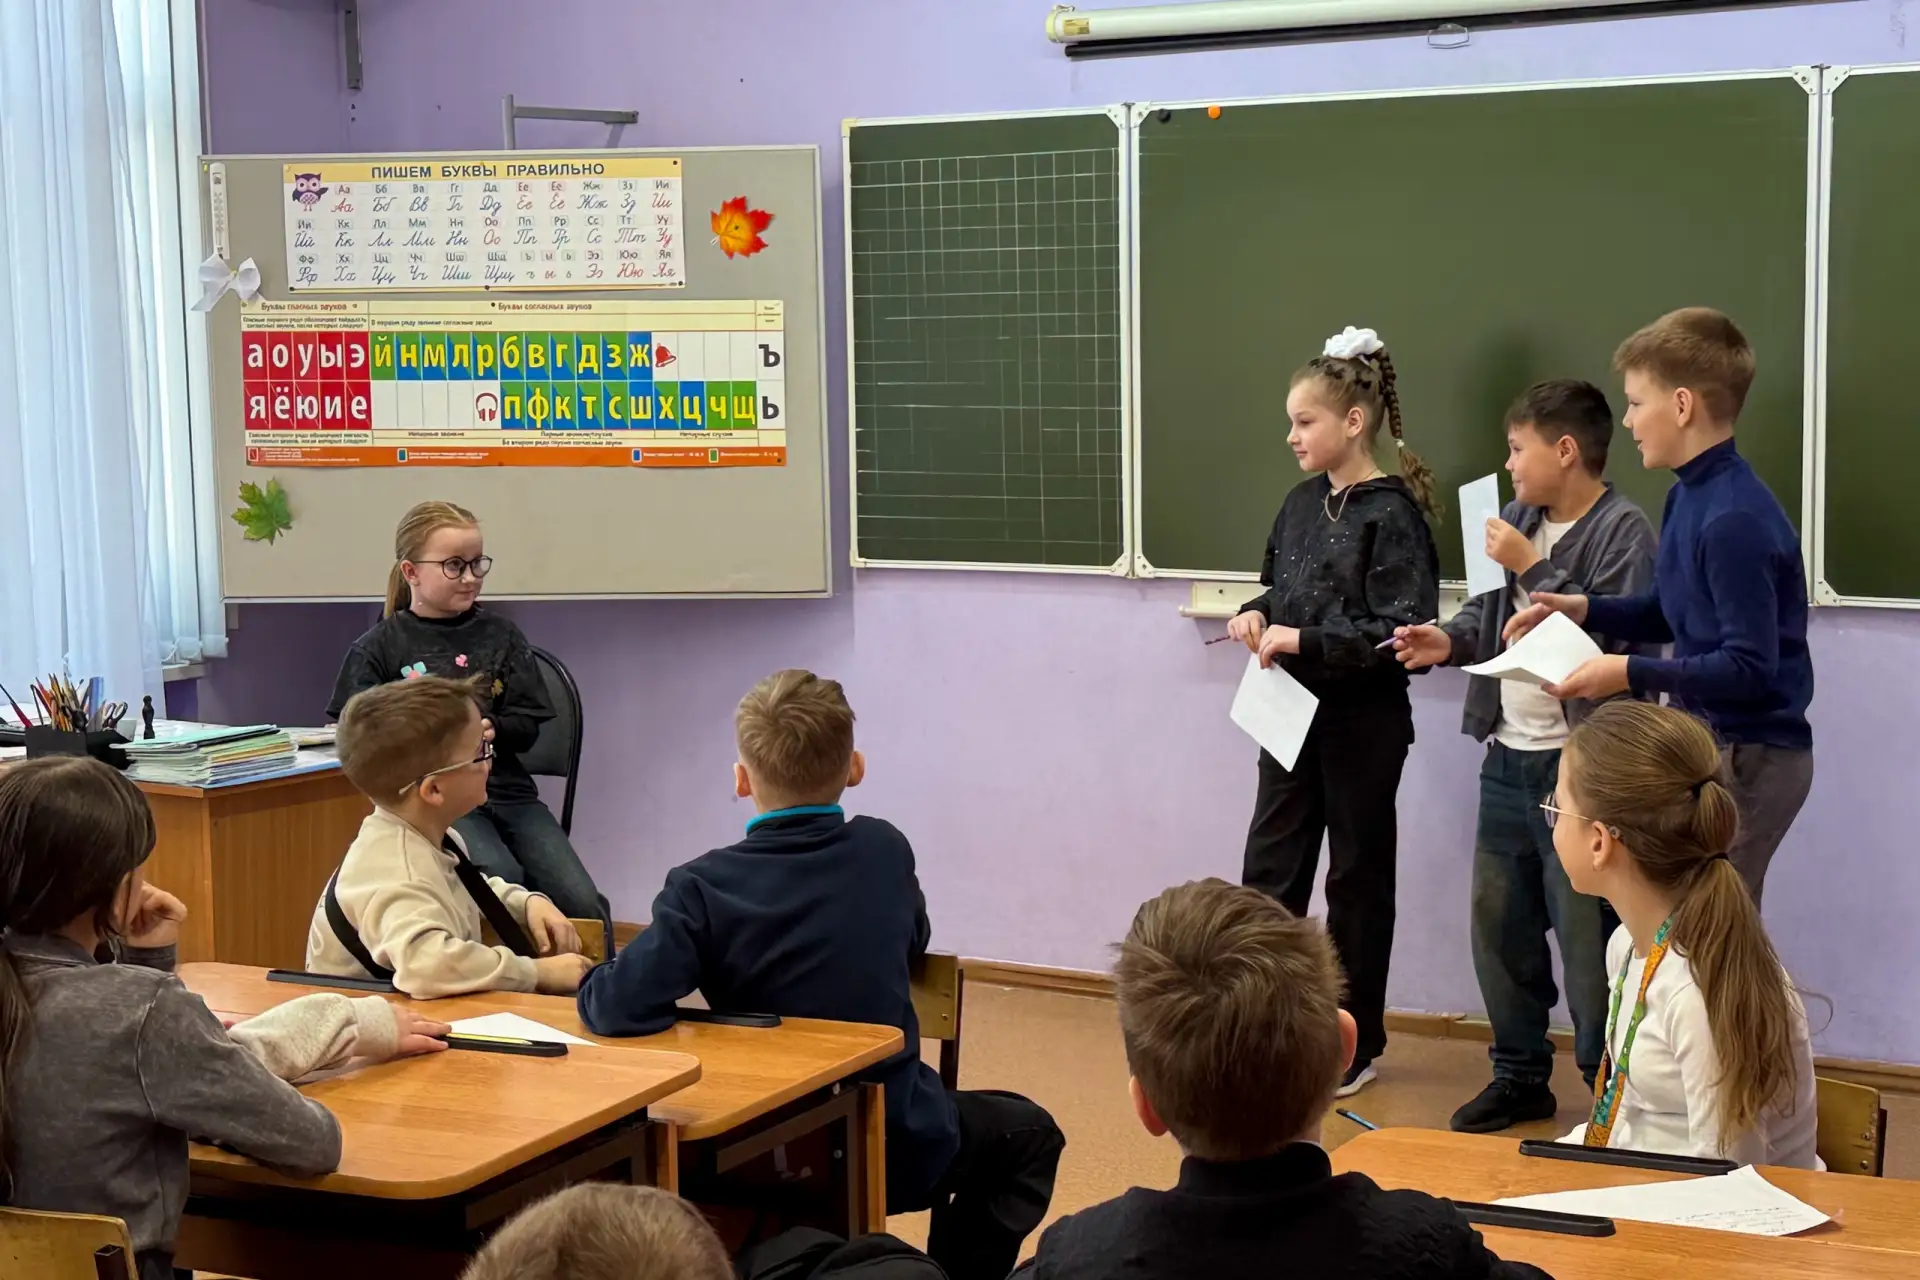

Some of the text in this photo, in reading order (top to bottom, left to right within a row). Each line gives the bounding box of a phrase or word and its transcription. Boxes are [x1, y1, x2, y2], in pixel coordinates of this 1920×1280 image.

[372, 164, 604, 178] ПИШЕМ БУКВЫ ПРАВИЛЬНО
[331, 198, 354, 212] Аа
[373, 197, 397, 211] Бб
[410, 197, 428, 211] Вв
[447, 196, 462, 211] Гг
[577, 194, 608, 209] Жж
[621, 193, 636, 214] Зз
[652, 193, 672, 208] Ии
[519, 217, 531, 225] Пп
[335, 232, 354, 247] Кк
[368, 232, 393, 246] Лл
[402, 232, 435, 246] Мм
[446, 231, 468, 246] Нн
[484, 229, 501, 244] Оо
[514, 229, 537, 244] Пп
[552, 228, 570, 249] Рр
[615, 227, 646, 243] Тт
[657, 227, 672, 248] Уу
[334, 267, 356, 282] Хх
[372, 266, 396, 284] Цц
[410, 266, 428, 282] Чч
[442, 265, 471, 280] Шш
[484, 265, 515, 283] Щщ
[617, 263, 643, 278] Юю
[653, 263, 676, 278] Яя
[262, 302, 286, 312] Буквы
[320, 304, 347, 312] звуков
[498, 302, 522, 311] Буквы
